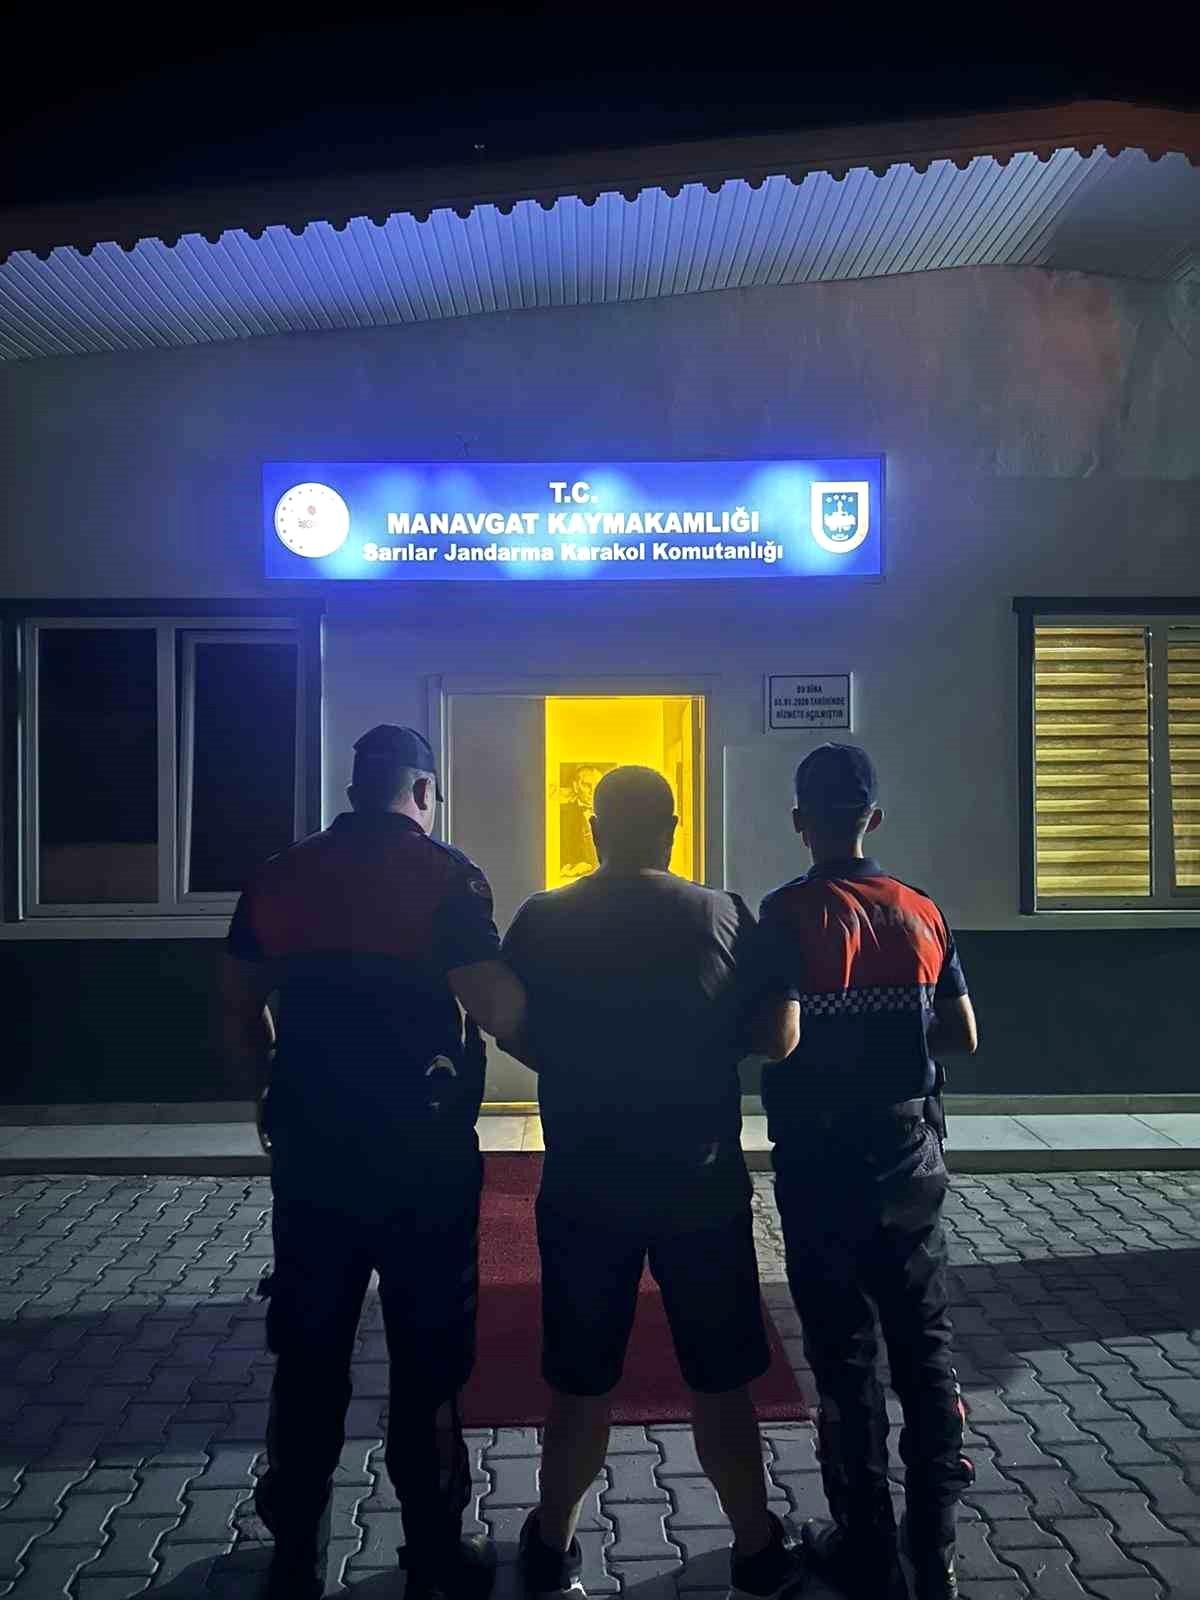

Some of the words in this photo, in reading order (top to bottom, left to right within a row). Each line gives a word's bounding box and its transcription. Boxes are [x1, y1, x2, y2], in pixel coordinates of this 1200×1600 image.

[549, 481, 599, 504] T.C.
[387, 512, 540, 535] MANAVGAT
[547, 506, 761, 534] KAYMAKAMLIĞI
[362, 542, 439, 562] Sarılar
[443, 542, 555, 562] Jandarma
[560, 542, 646, 561] Karakol
[652, 541, 784, 564] Komutanlığı
